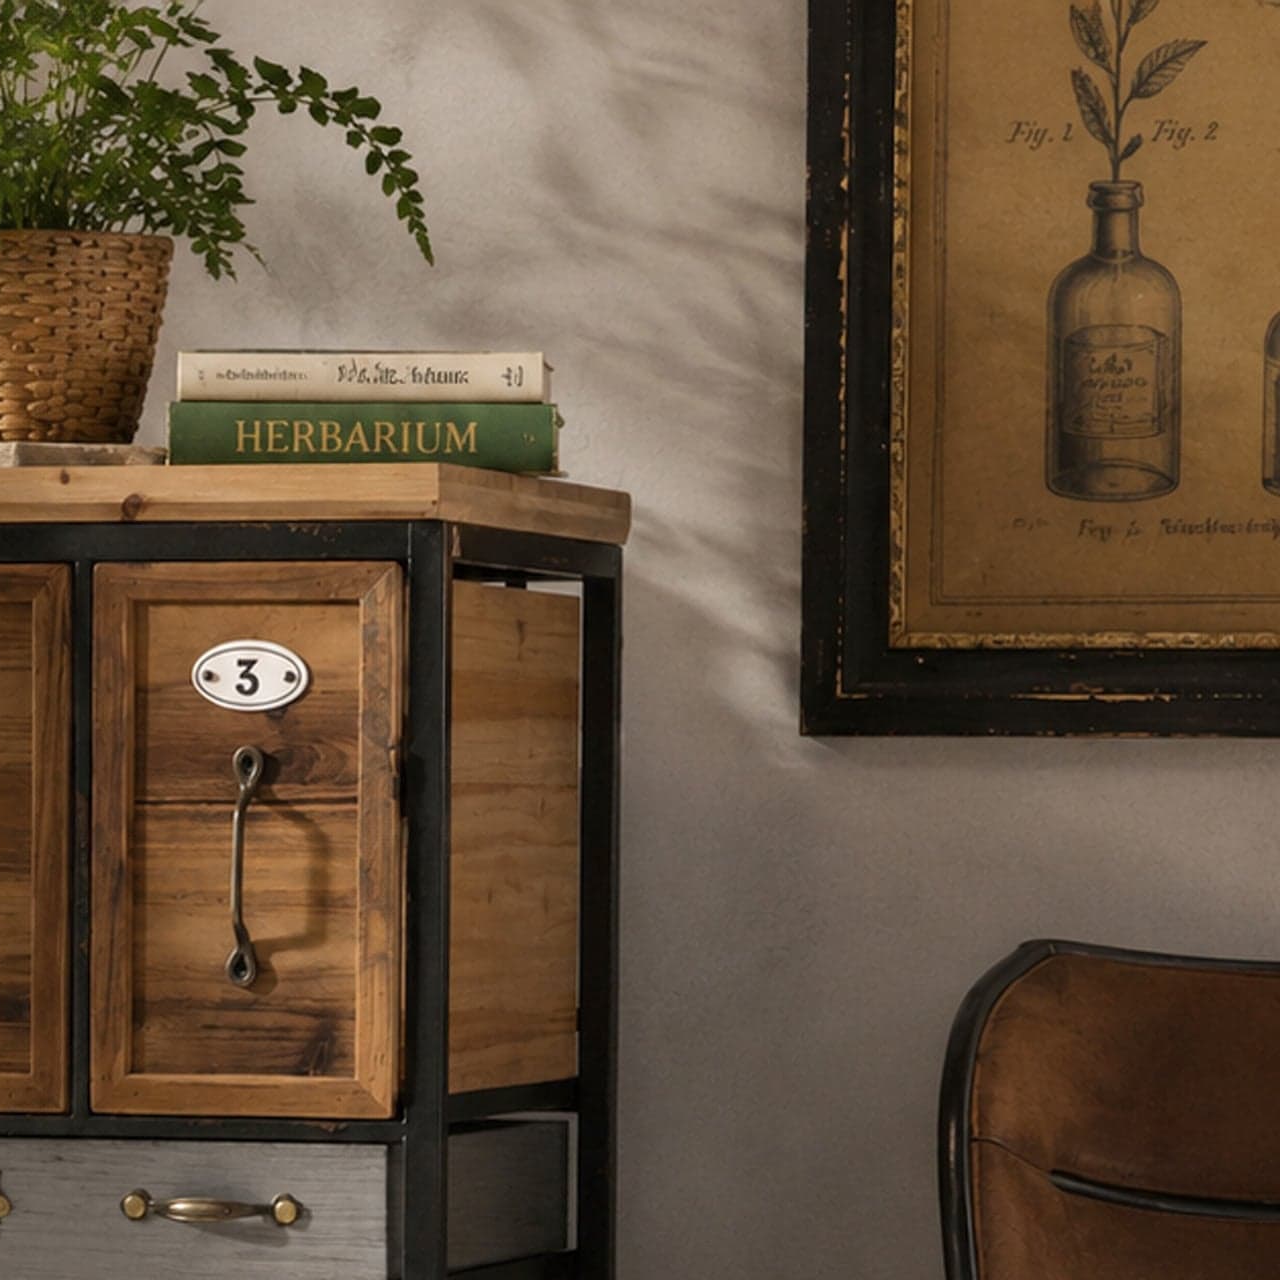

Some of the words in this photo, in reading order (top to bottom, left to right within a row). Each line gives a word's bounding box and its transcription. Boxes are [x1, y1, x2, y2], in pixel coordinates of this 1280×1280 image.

[1005, 120, 1054, 150] Fig.
[1151, 119, 1196, 150] Fig.
[1204, 121, 1219, 141] 2
[235, 419, 479, 454] HERBARIUM
[235, 659, 260, 697] 3
